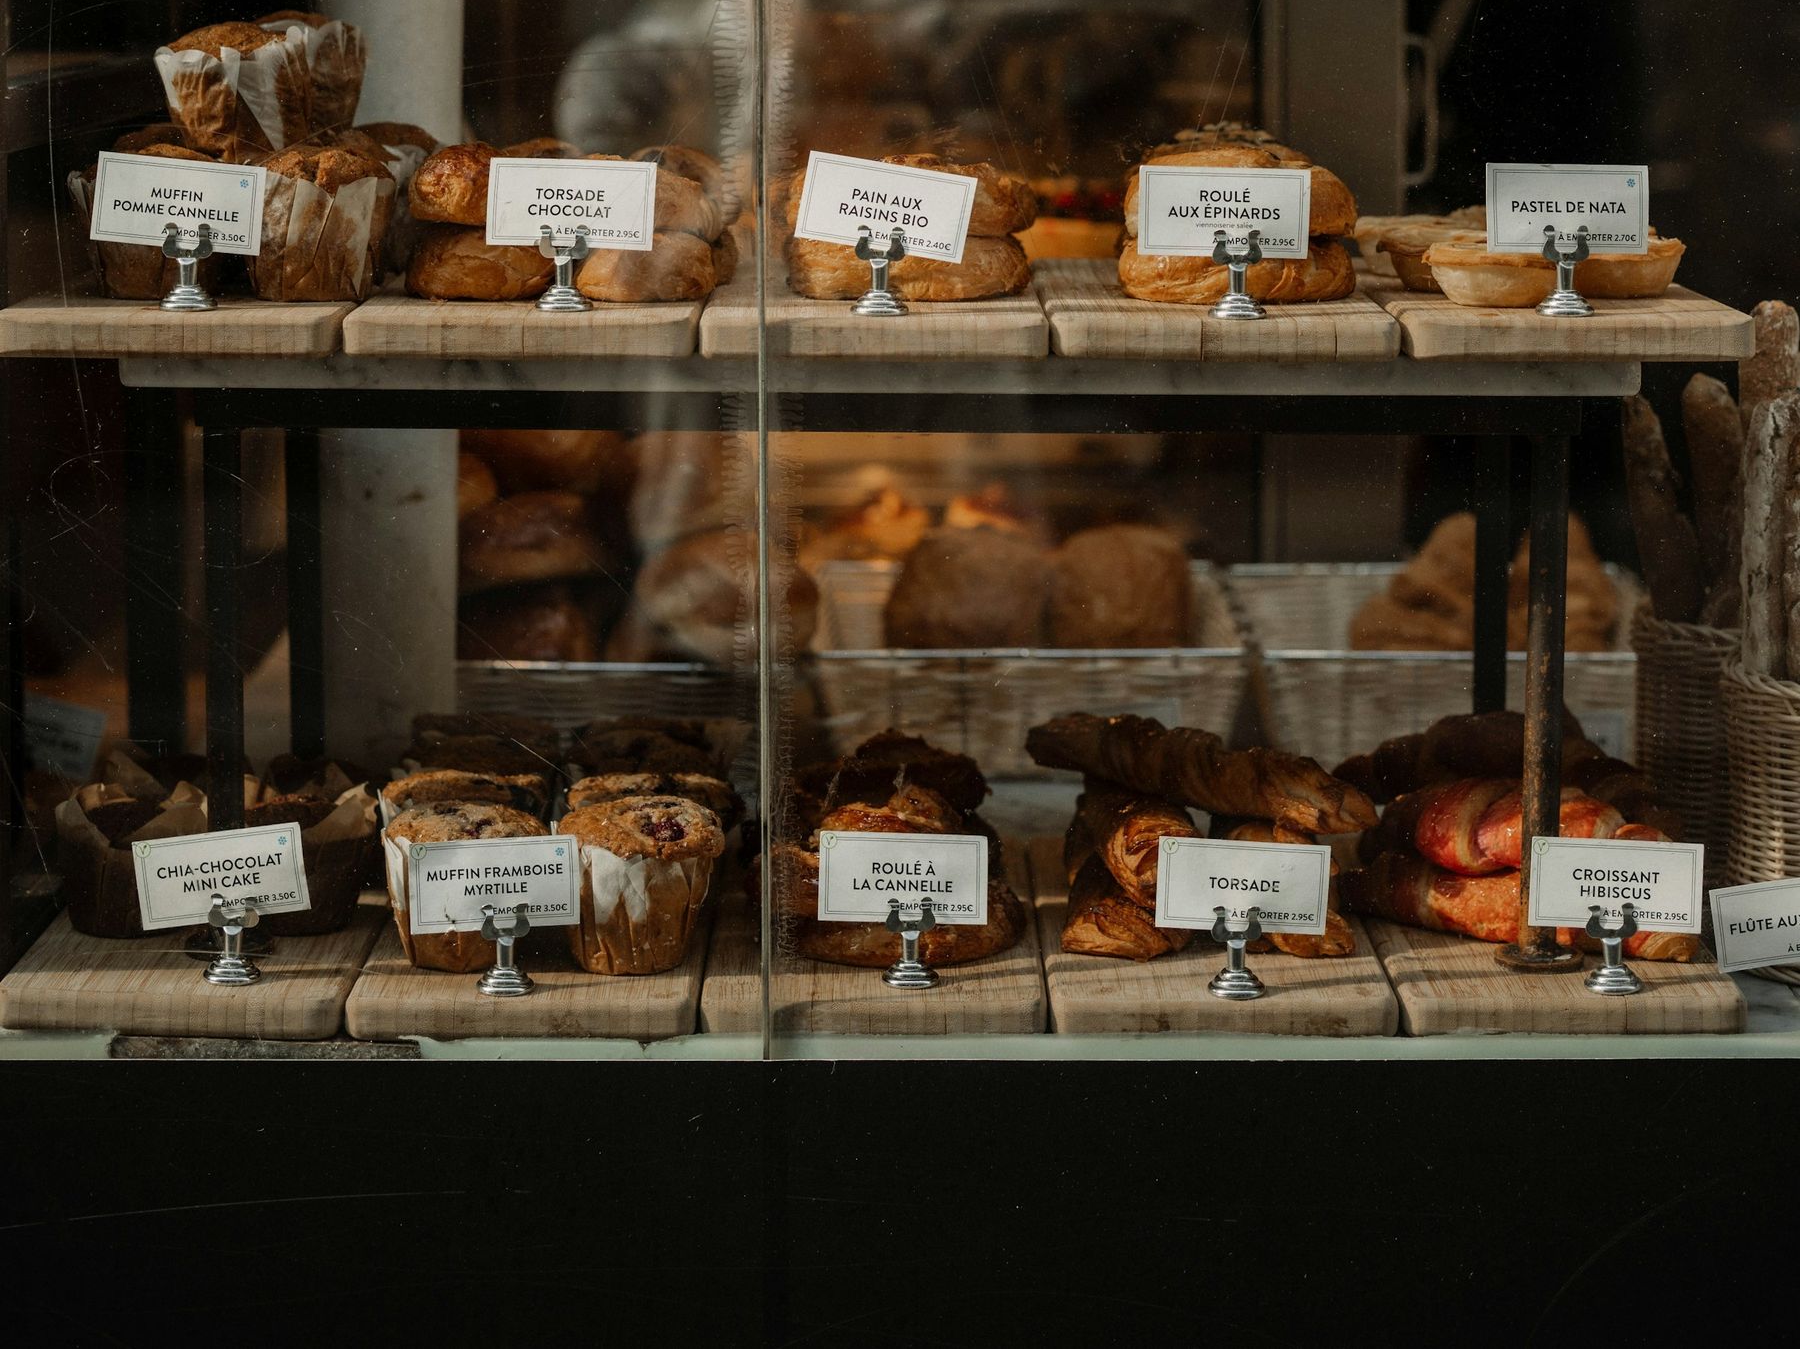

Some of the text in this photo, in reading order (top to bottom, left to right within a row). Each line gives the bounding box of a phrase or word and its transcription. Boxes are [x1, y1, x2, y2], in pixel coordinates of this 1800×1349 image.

[151, 187, 203, 203] MUFFIN
[536, 188, 606, 202] TORSADE
[851, 188, 923, 211] PAIN AUX
[1199, 188, 1251, 203] ROULÉ
[113, 200, 240, 222] POMME CANNELLE
[527, 204, 612, 219] CHOCOLAT
[1168, 203, 1281, 220] AUX ÉPINARDS
[1512, 200, 1626, 214] PASTEL DE NATA
[838, 203, 929, 228] RAISINS BIO
[221, 233, 246, 243] 3.50€
[616, 230, 640, 239] 2.95€
[1614, 234, 1637, 242] 2.70€
[926, 240, 951, 251] 2.40€
[1272, 238, 1295, 247] 2.95€
[157, 853, 283, 879] CHIA-CHOCOLAT
[426, 863, 563, 882] MUFFIN FRAMBOISE
[872, 860, 936, 876] ROULÉ À
[183, 872, 261, 893] MINI CAKE
[1572, 868, 1660, 884] CROISSANT
[464, 882, 528, 896] MYRTILLE
[853, 878, 953, 893] LA CANNELLE
[1209, 876, 1280, 893] TORSADE
[271, 891, 296, 902] 3.50€
[1580, 885, 1651, 900] HIBISCUS
[950, 904, 973, 912] 2.95€
[1291, 913, 1315, 921] 2.95€
[1730, 918, 1774, 935] FLÛTE
